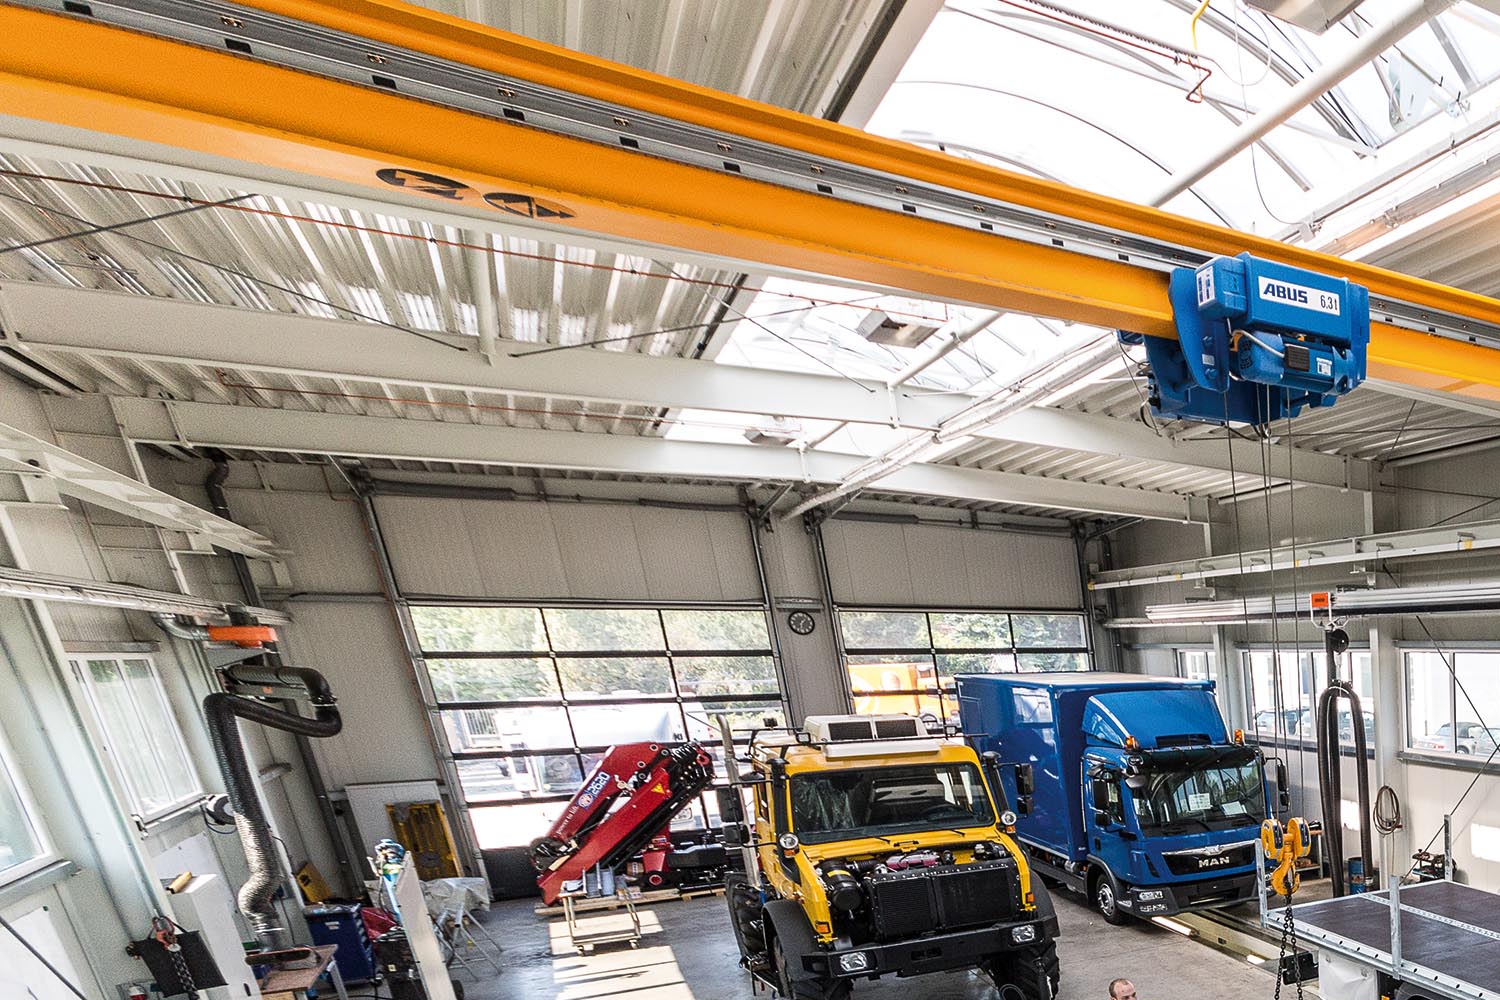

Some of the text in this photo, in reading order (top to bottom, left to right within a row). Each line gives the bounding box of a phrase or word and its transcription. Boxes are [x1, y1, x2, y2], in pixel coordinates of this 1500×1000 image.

[1263, 283, 1308, 304] ABUS
[588, 771, 610, 796] 2620
[1198, 856, 1230, 868] MAN
